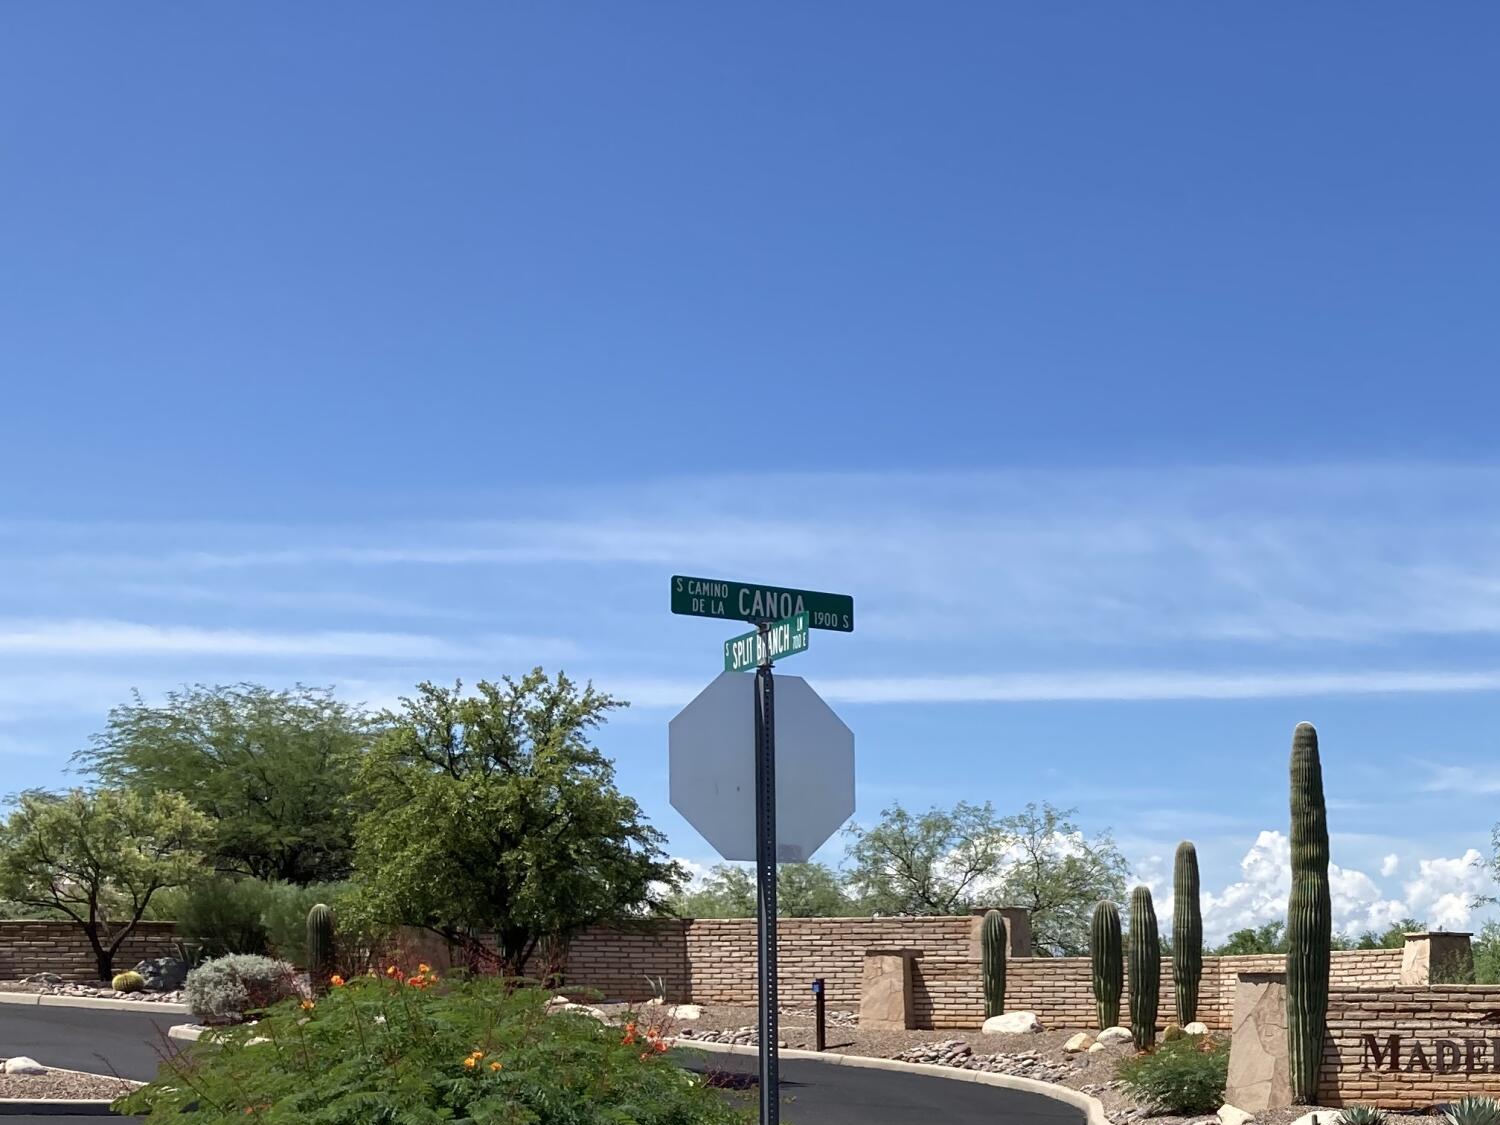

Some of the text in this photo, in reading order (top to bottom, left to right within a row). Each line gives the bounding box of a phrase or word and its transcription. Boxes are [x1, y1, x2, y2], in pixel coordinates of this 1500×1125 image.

[677, 578, 728, 598] S CAMINO
[693, 598, 724, 614] DE LA
[739, 588, 805, 618] CANOA
[814, 611, 848, 628] 1900 S
[725, 643, 729, 656] S
[733, 637, 753, 669] SPLIT
